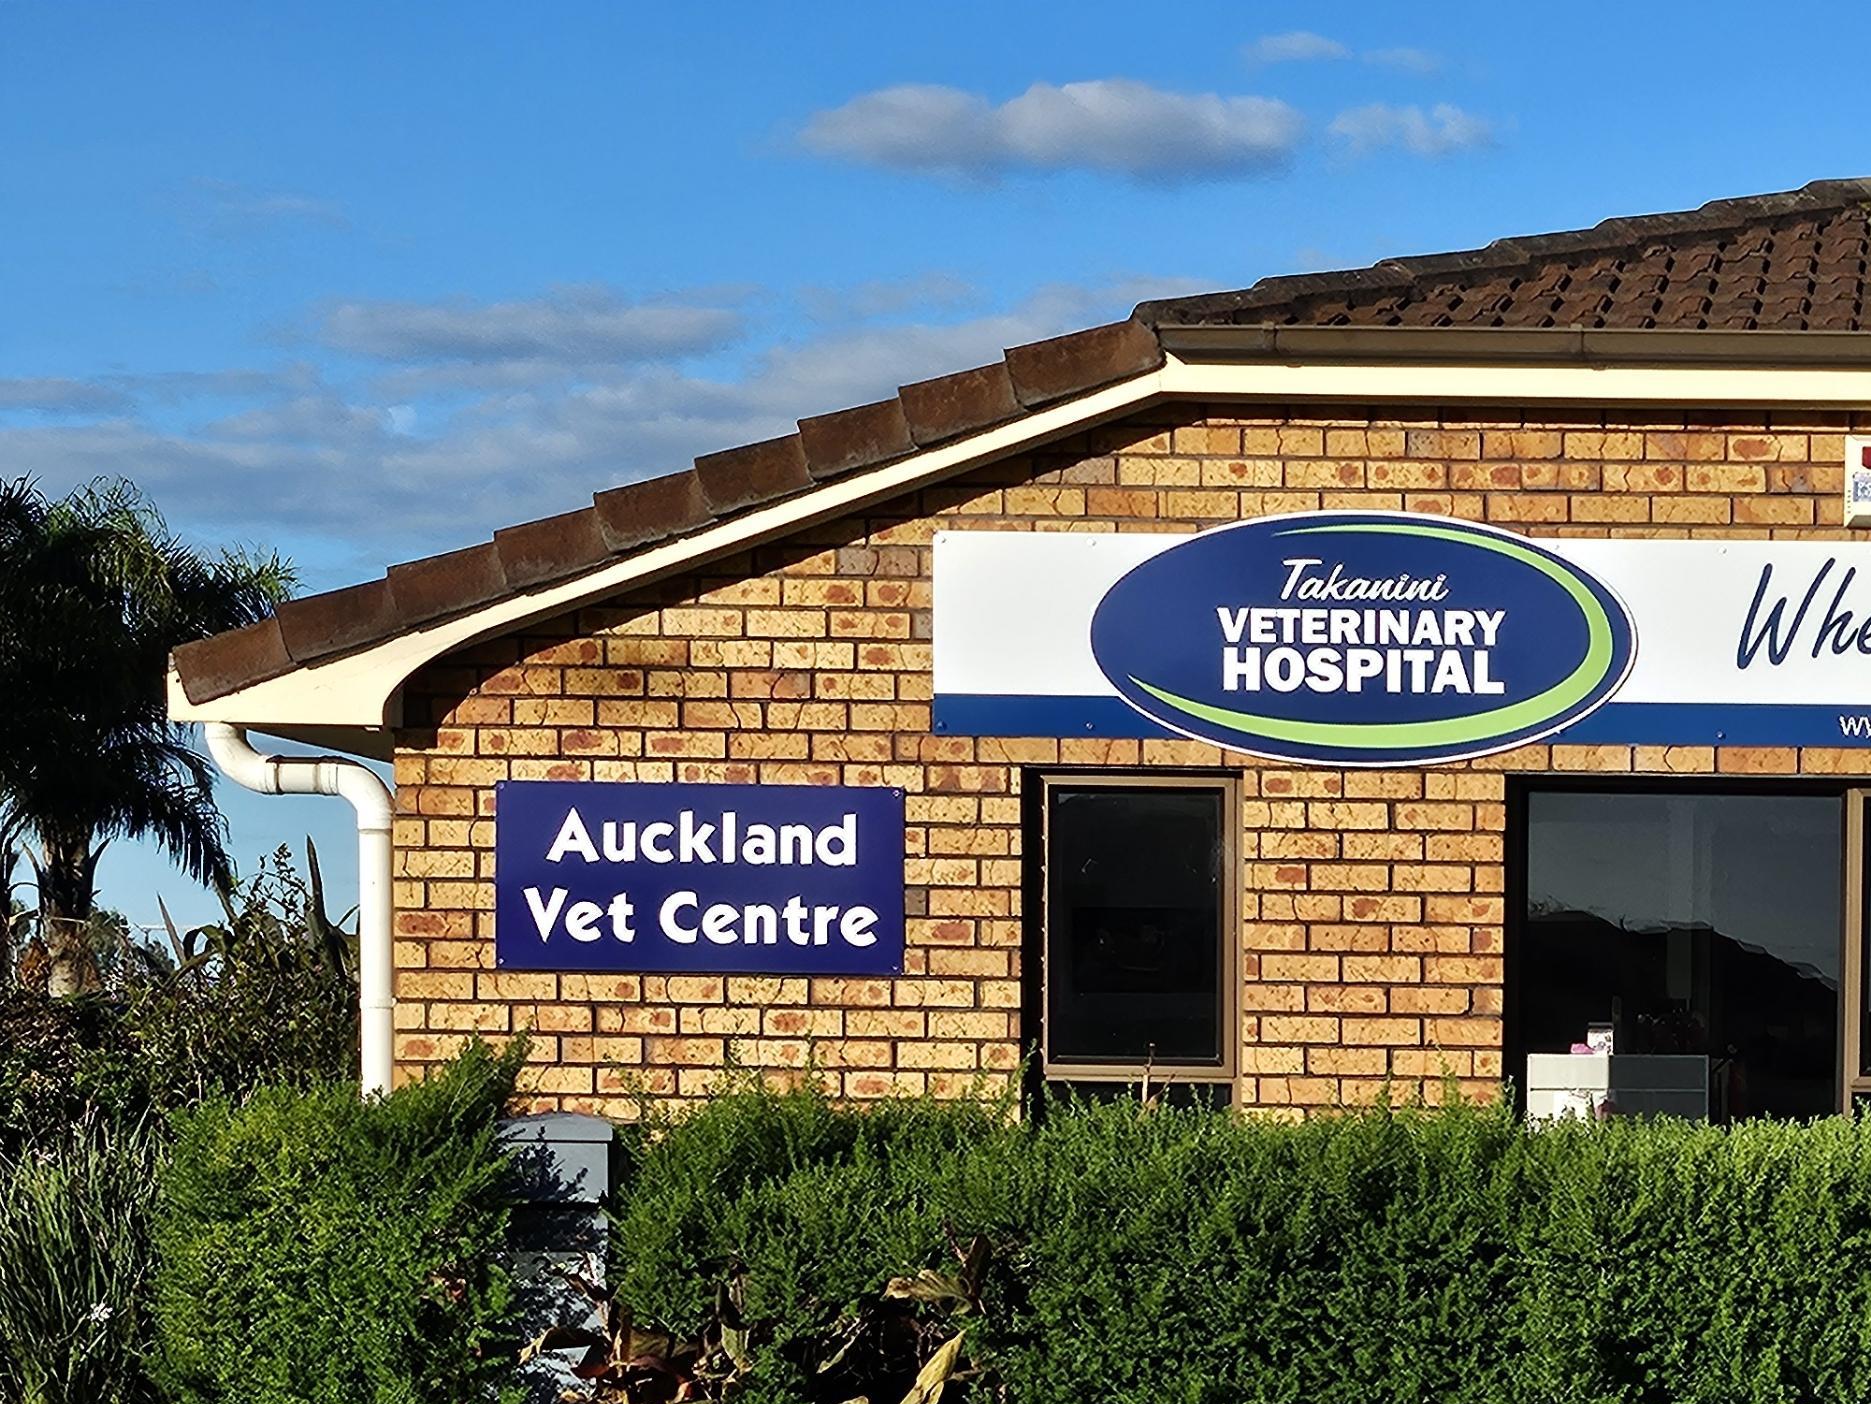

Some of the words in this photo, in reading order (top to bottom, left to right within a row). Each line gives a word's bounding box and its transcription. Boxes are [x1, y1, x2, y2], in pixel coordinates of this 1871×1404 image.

[1280, 558, 1449, 601] Takanini
[1216, 607, 1506, 646] VETERINARY
[1223, 646, 1505, 694] HOSPITAL
[545, 807, 857, 867] Auckland
[523, 886, 636, 943] Vet
[659, 891, 879, 947] Centre
